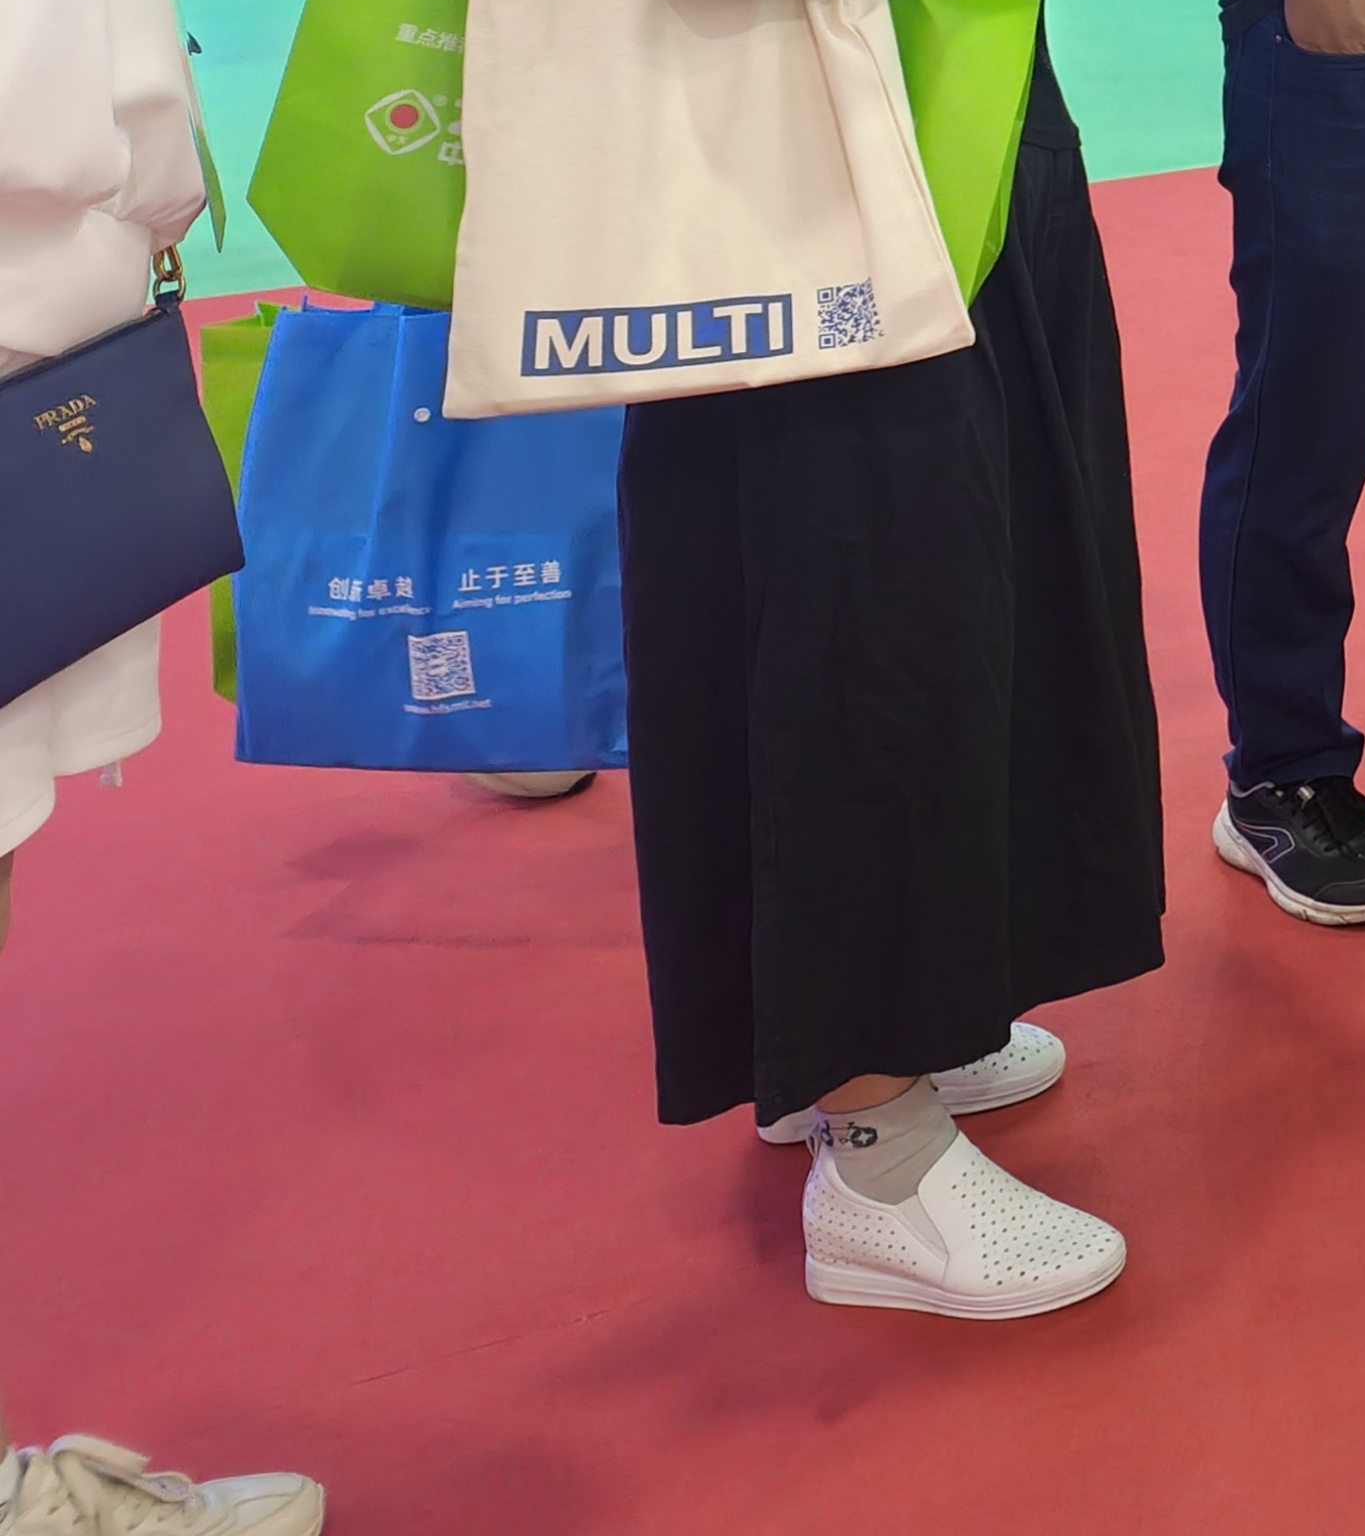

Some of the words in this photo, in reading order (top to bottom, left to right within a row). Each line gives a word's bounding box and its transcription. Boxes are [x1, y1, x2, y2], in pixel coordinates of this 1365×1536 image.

[534, 301, 785, 370] MULTI
[34, 394, 97, 431] PRADA
[458, 559, 561, 592] 止于至善
[494, 593, 512, 605] for
[514, 588, 572, 605] perfection
